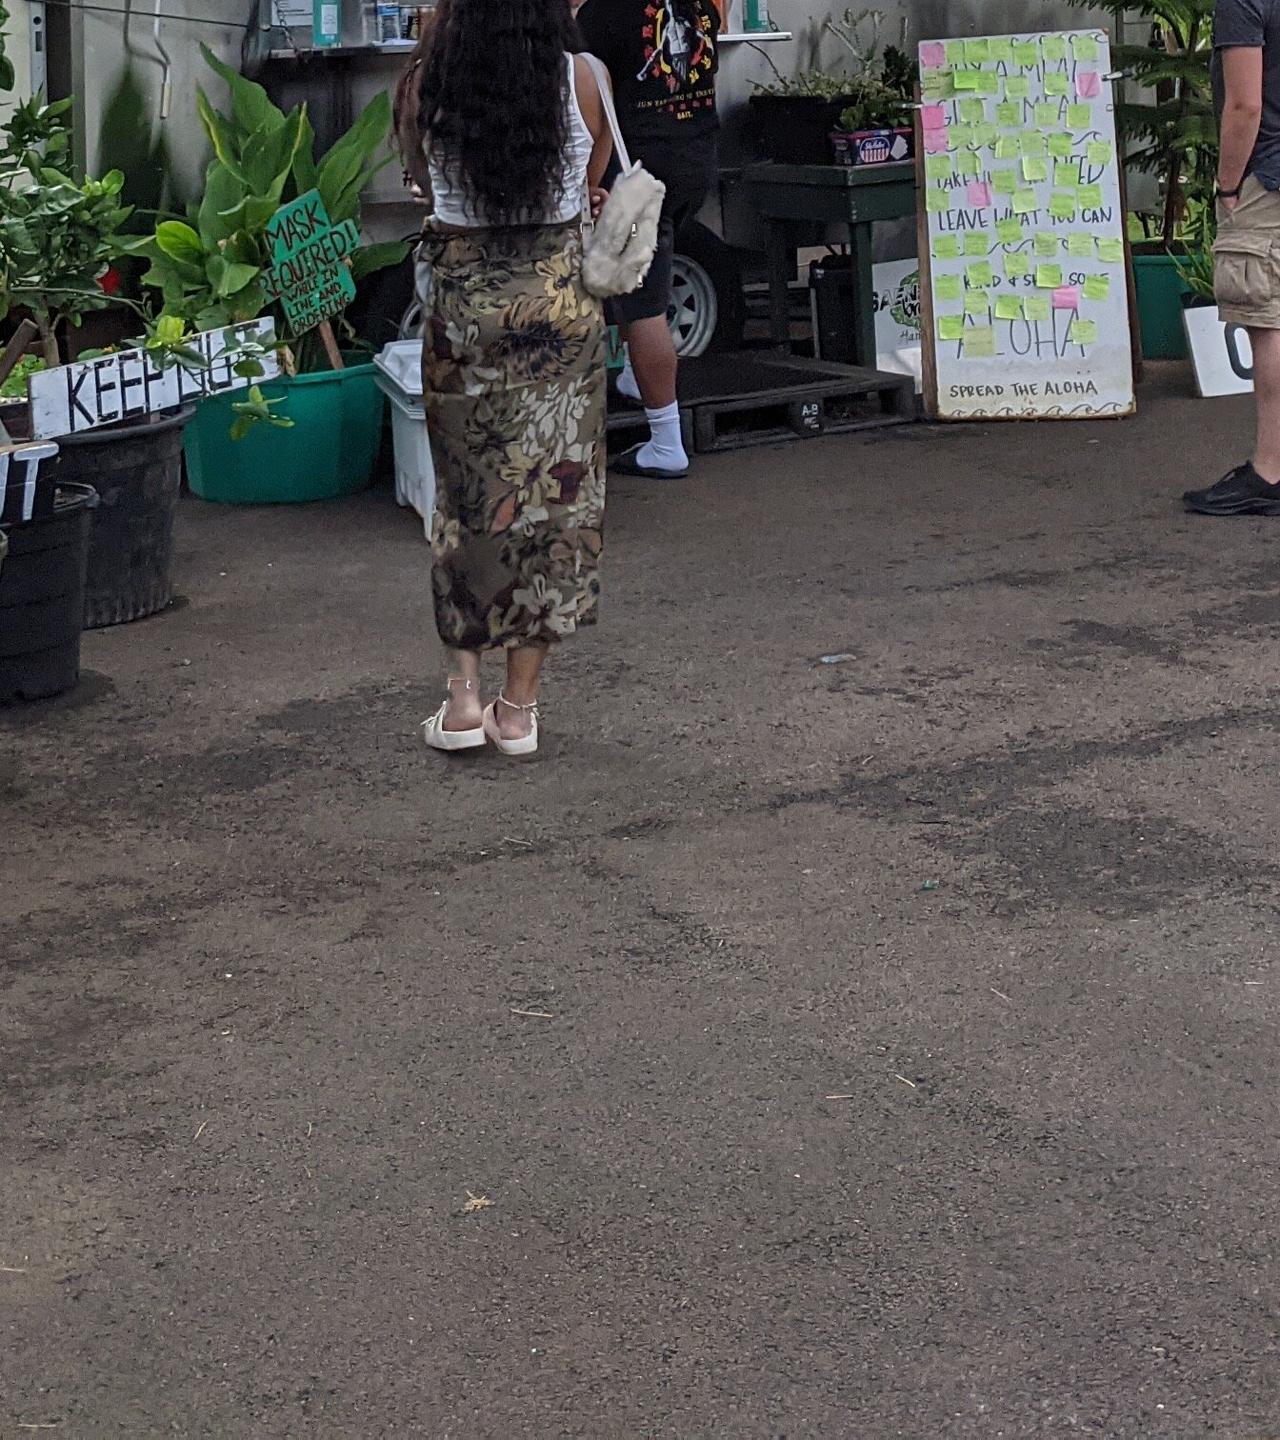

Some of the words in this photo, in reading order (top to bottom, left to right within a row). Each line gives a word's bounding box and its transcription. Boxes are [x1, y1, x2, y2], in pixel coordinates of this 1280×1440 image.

[1053, 155, 1105, 185] ED
[264, 200, 327, 252] MASK
[938, 207, 988, 231] LEAVE
[1081, 206, 1112, 224] CAN
[260, 222, 356, 297] REQUIRED!
[323, 265, 339, 284] IN
[964, 275, 1002, 290] KD
[288, 295, 316, 318] LINE
[318, 281, 341, 300] AND
[292, 291, 350, 333] ORDERING
[873, 284, 920, 312] SAEN
[67, 348, 164, 432] KEEP
[950, 384, 1004, 398] SPREAD
[1010, 382, 1038, 396] THE
[1044, 380, 1098, 395] ALOHA
